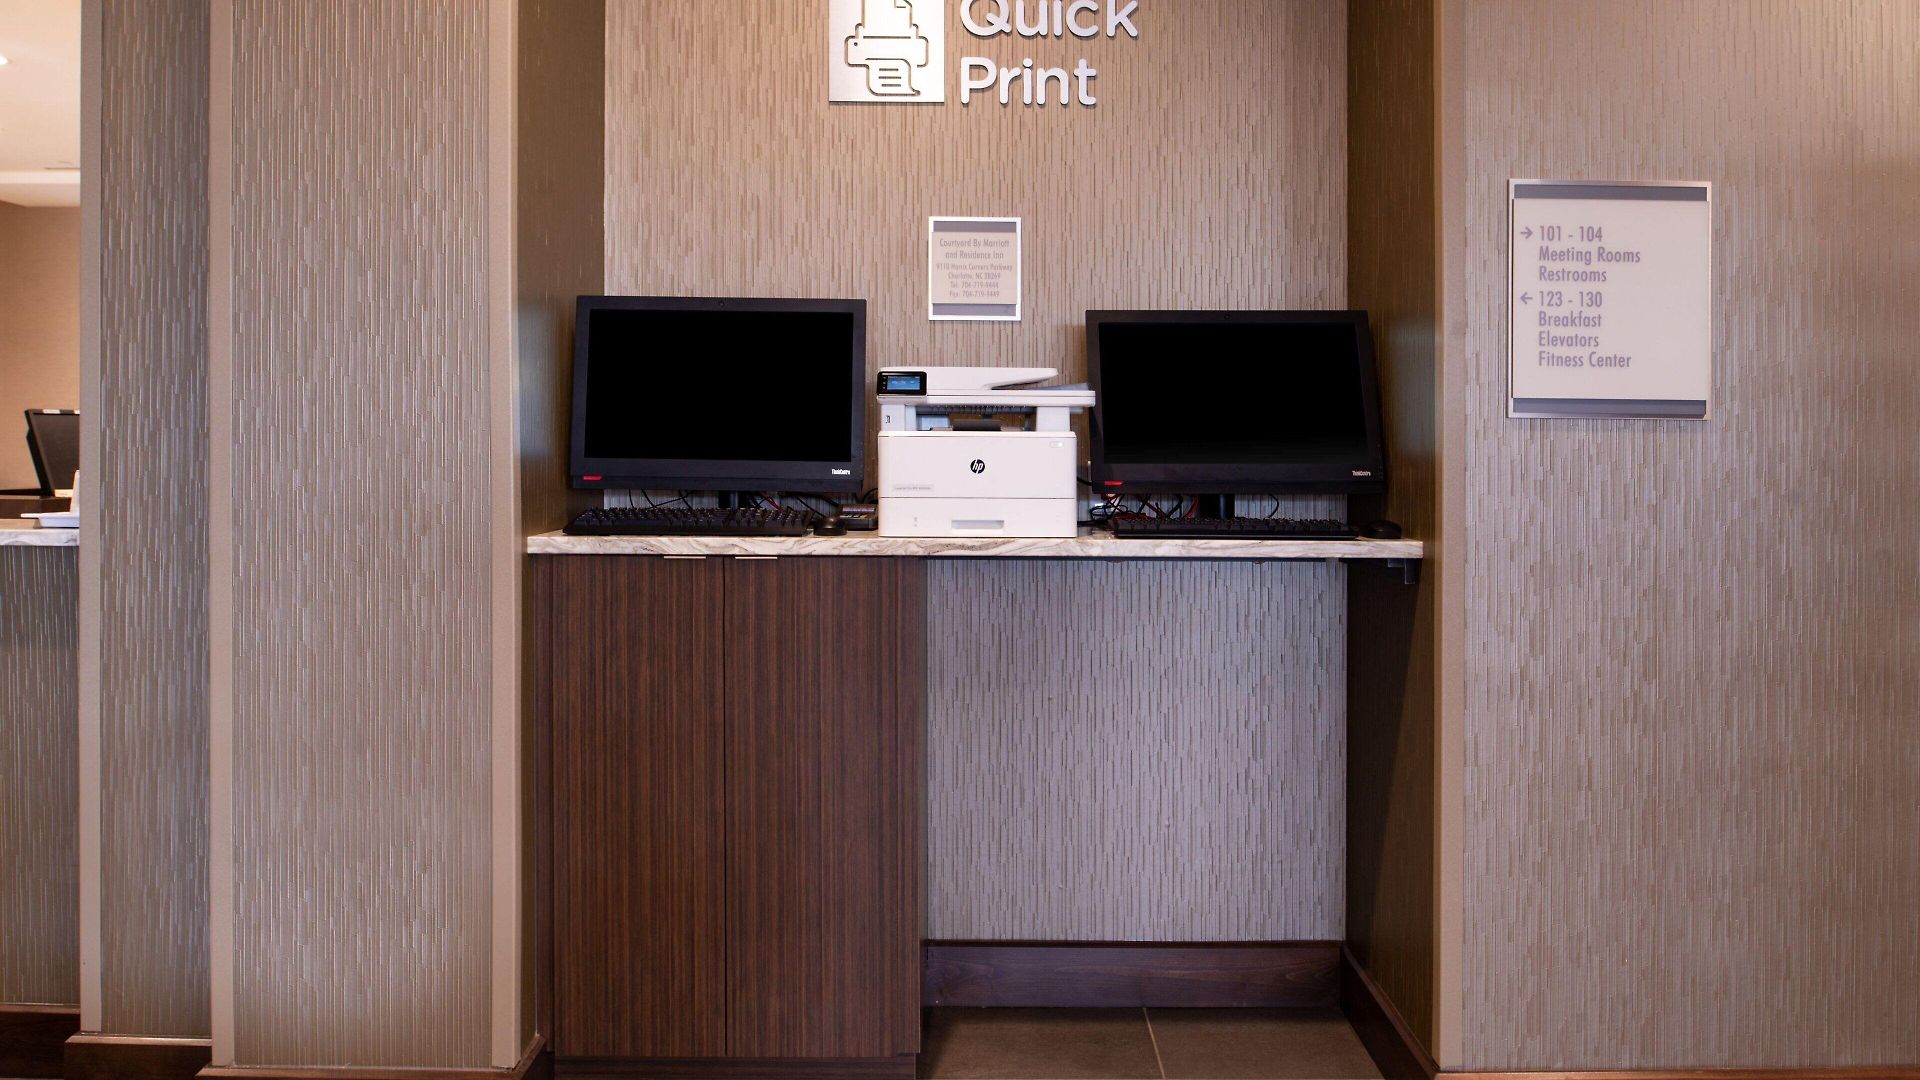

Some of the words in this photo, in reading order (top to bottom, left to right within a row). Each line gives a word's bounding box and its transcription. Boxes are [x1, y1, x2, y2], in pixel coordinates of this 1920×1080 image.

[960, 0, 1138, 38] Quick
[960, 56, 1097, 105] Print
[1539, 226, 1561, 242] 101
[1579, 226, 1603, 242] 104
[939, 238, 971, 248] Courtyard
[973, 239, 981, 249] By
[983, 239, 1010, 248] Marriott
[945, 251, 957, 259] and
[960, 251, 991, 259] Residence
[993, 251, 1004, 259] Inn
[1538, 246, 1592, 265] Meeting
[1597, 247, 1641, 263] Rooms
[1538, 266, 1607, 282] Restrooms
[1539, 291, 1563, 307] 123
[1579, 291, 1603, 308] 130
[1538, 311, 1602, 327] Breakfast
[1538, 331, 1599, 347] Elevators
[1538, 351, 1584, 367] Fitness
[1589, 351, 1632, 368] Center
[970, 459, 985, 475] hp
